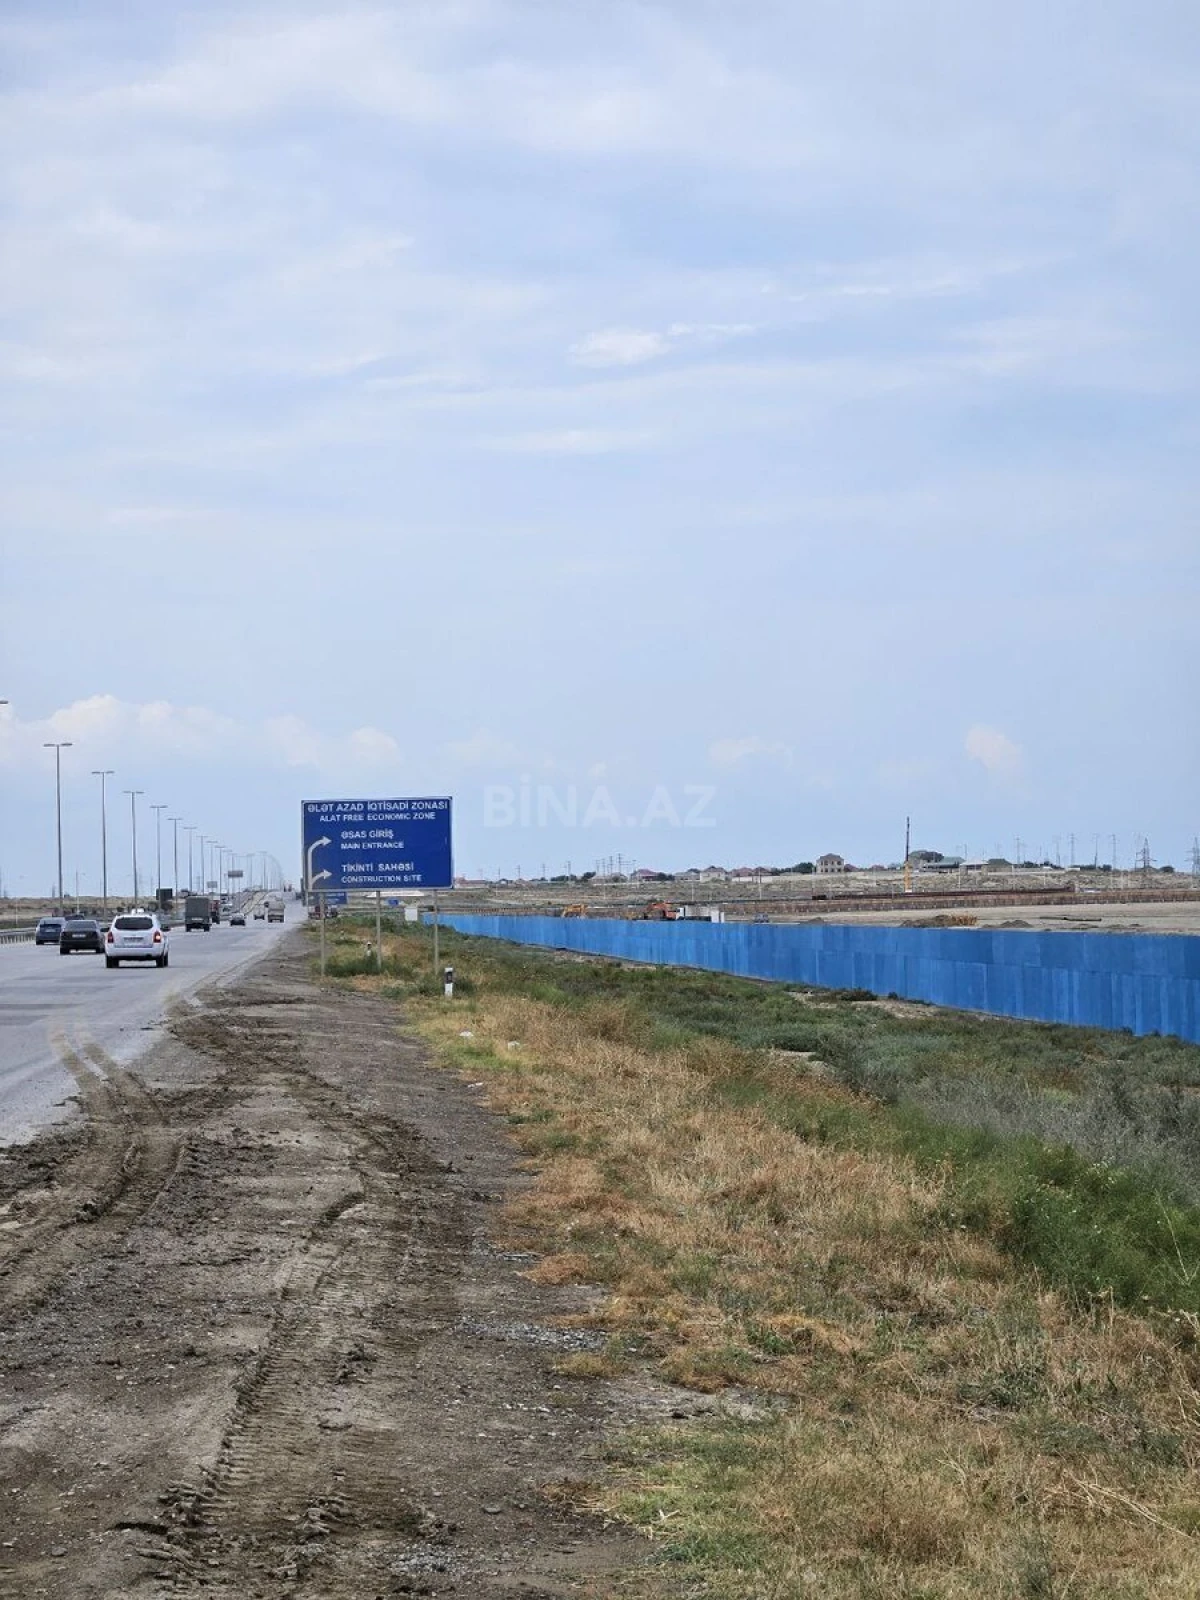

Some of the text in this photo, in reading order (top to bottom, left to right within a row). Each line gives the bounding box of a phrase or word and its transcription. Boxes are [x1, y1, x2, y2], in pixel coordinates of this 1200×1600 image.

[308, 803, 334, 812] ƏLƏT
[336, 802, 364, 812] AZAD
[412, 800, 448, 810] ZONASI
[368, 813, 410, 821] ECONOMIC
[341, 828, 394, 840] ƏSAS GİRİŞ
[362, 841, 404, 850] ENTRANCE
[378, 862, 414, 872] SAHƏSİ
[341, 874, 400, 884] CONSTRUCTION
